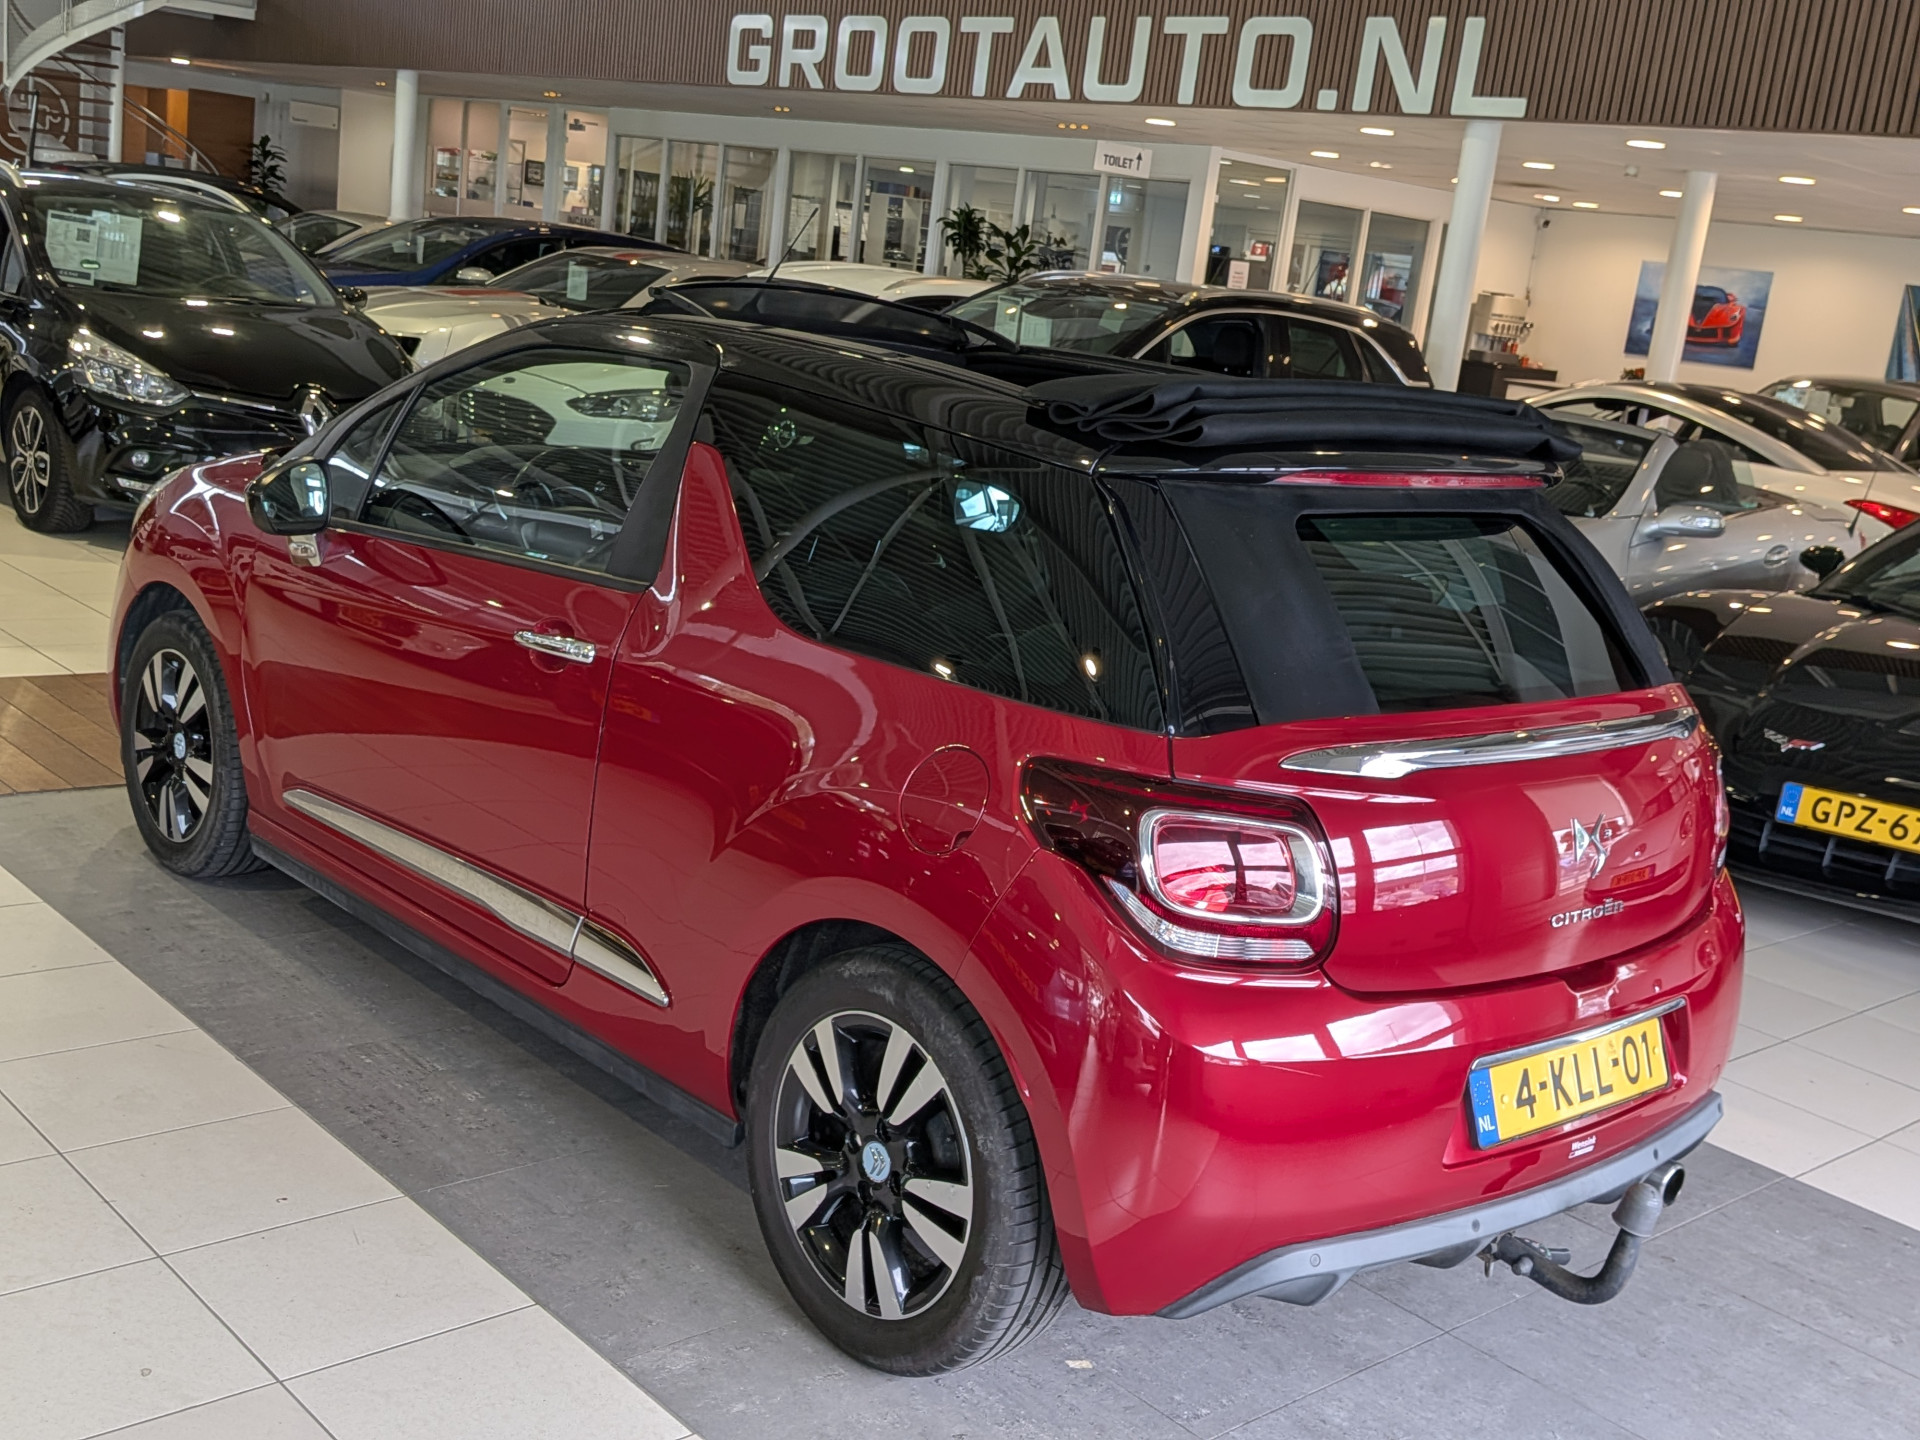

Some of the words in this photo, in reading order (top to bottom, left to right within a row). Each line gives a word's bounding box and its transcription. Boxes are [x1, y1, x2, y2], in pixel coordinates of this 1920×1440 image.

[726, 14, 1528, 118] GROOTAUTO.NL
[1103, 153, 1134, 170] TOILET
[1780, 805, 1795, 817] NL
[1514, 1030, 1653, 1119] 4-KLL-01
[1478, 1115, 1496, 1134] NL
